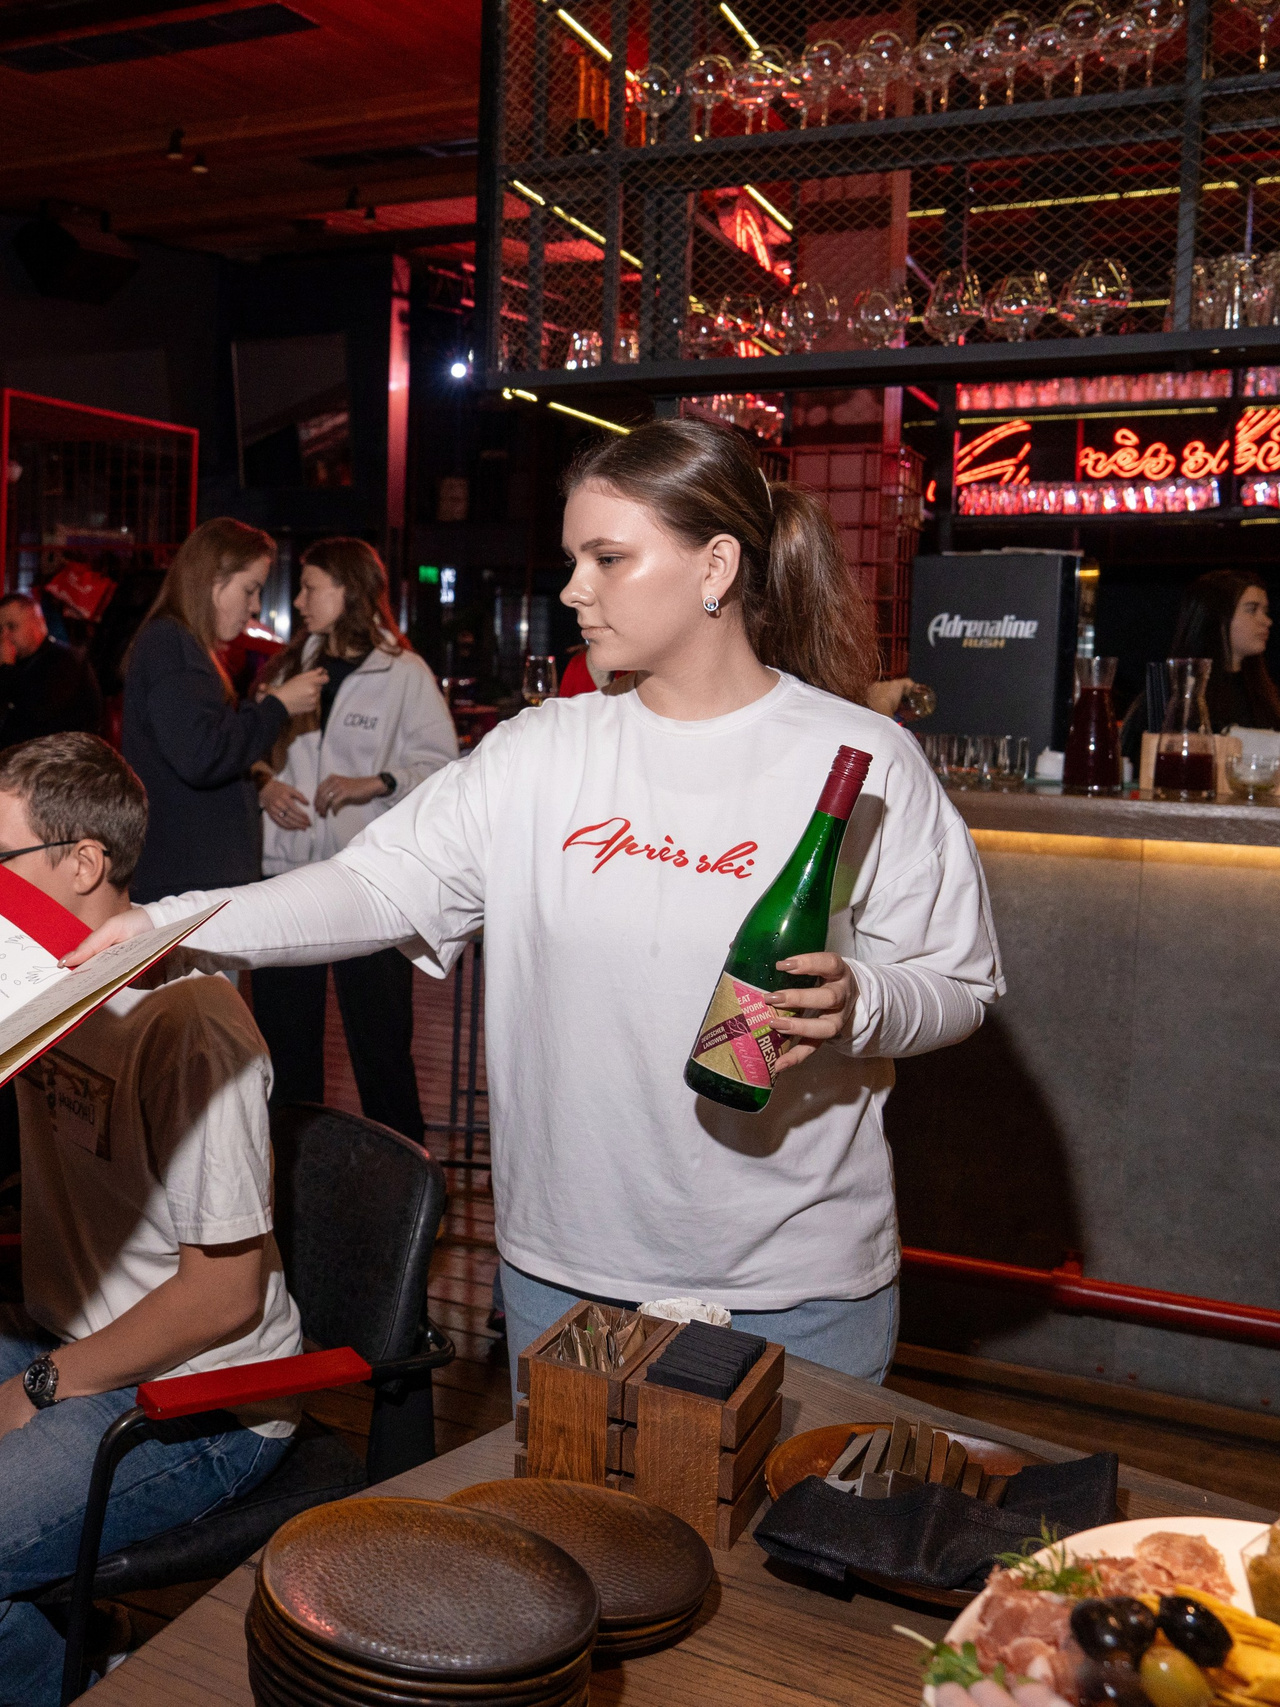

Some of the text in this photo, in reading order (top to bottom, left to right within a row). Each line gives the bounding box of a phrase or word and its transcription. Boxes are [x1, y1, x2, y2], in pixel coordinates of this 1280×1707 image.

[928, 612, 1039, 648] Adrenaline
[962, 637, 1006, 649] RUSH
[562, 817, 759, 879] Après ski
[737, 993, 751, 1005] EAT
[741, 1001, 765, 1014] WORK
[746, 1011, 772, 1026] DRINK
[703, 1033, 728, 1050] LANDWEIN
